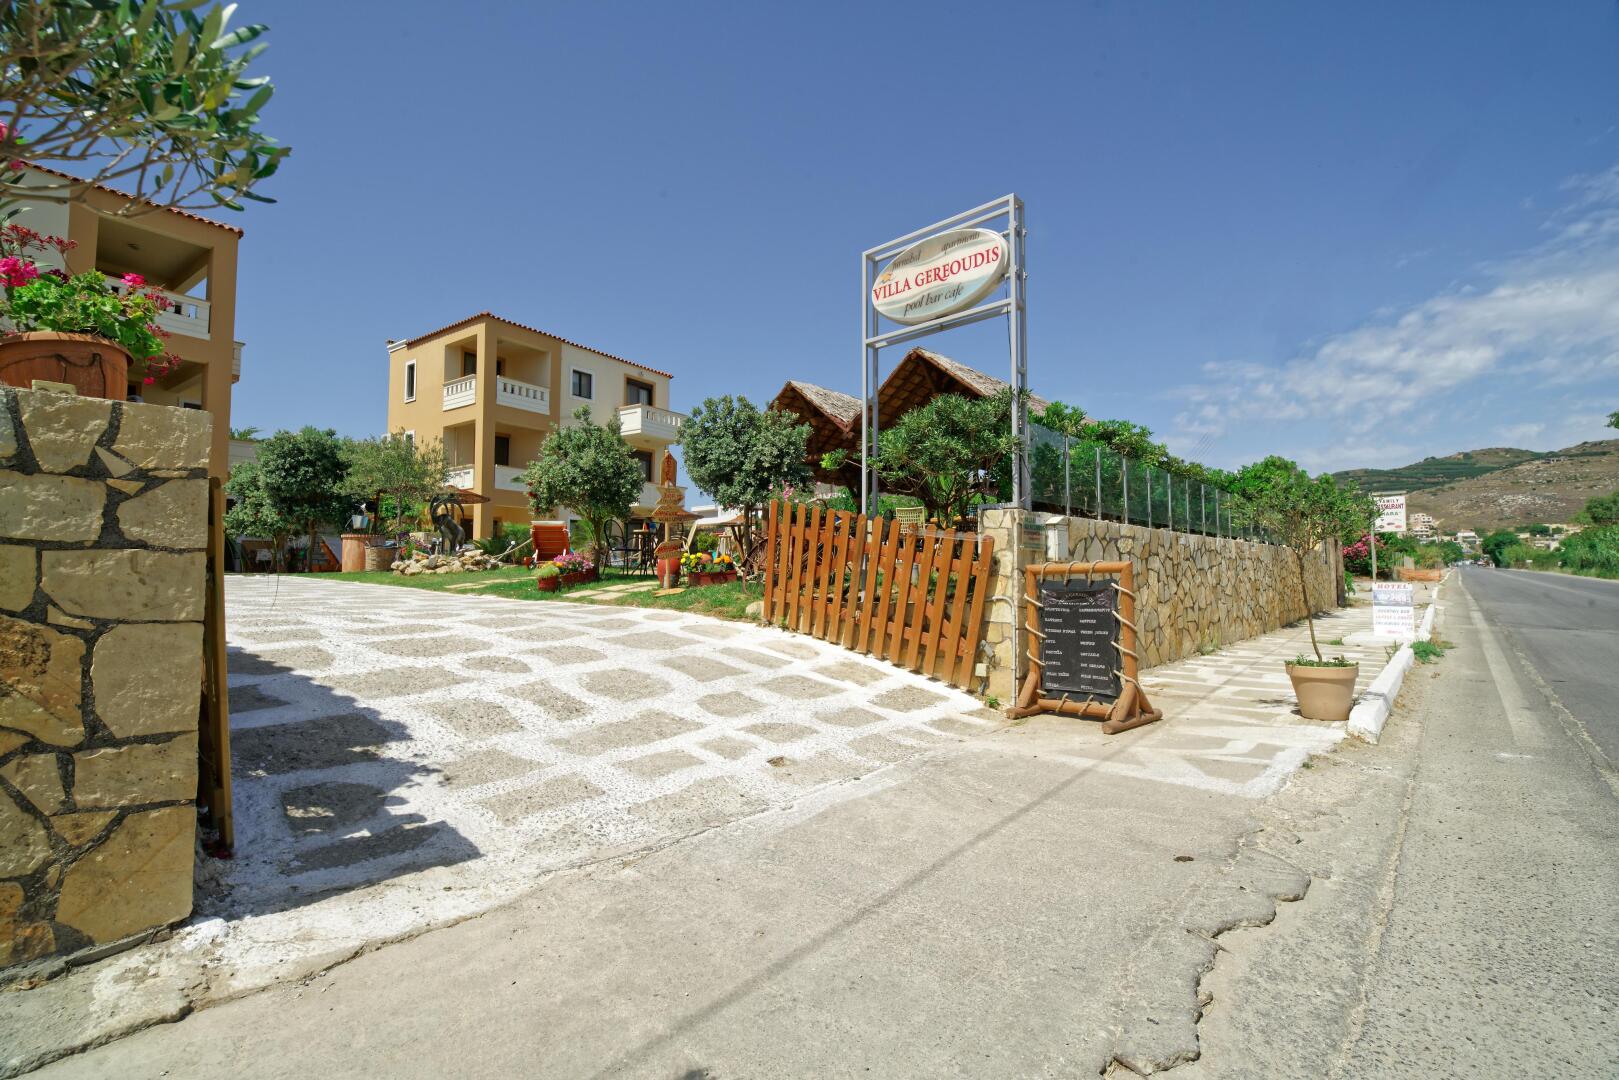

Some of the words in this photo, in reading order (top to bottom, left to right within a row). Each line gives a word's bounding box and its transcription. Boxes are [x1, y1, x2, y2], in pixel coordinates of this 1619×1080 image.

[873, 278, 912, 301] VILLA
[915, 246, 1000, 287] GERFOUDIS
[903, 294, 925, 317] pool
[926, 292, 943, 306] bar
